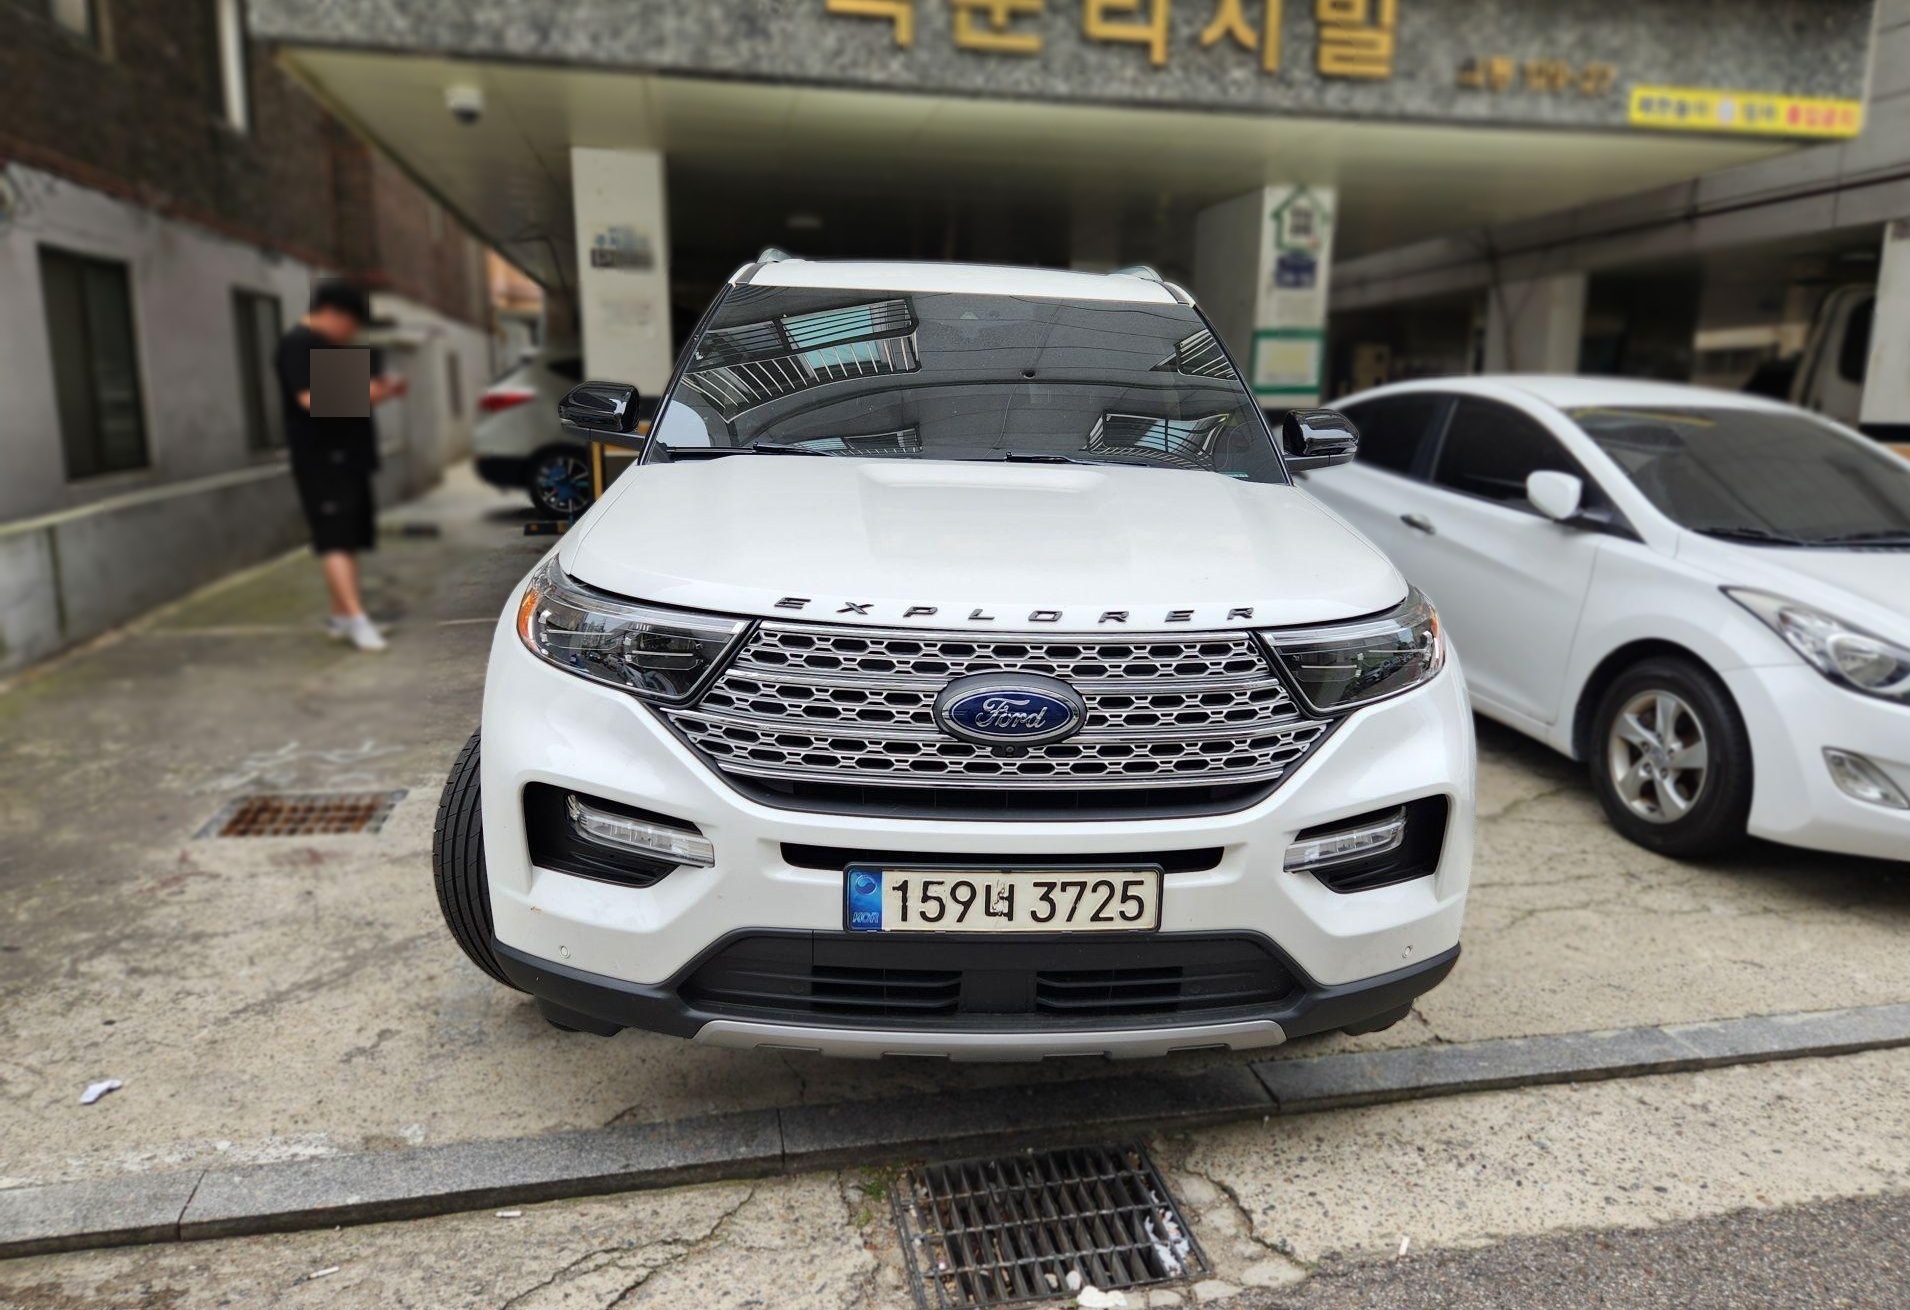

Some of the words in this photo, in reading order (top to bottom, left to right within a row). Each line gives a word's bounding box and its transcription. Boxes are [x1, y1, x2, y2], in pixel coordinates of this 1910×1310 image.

[773, 597, 1254, 624] EXPLORER
[975, 697, 1048, 728] Ford
[852, 911, 880, 924] KOR
